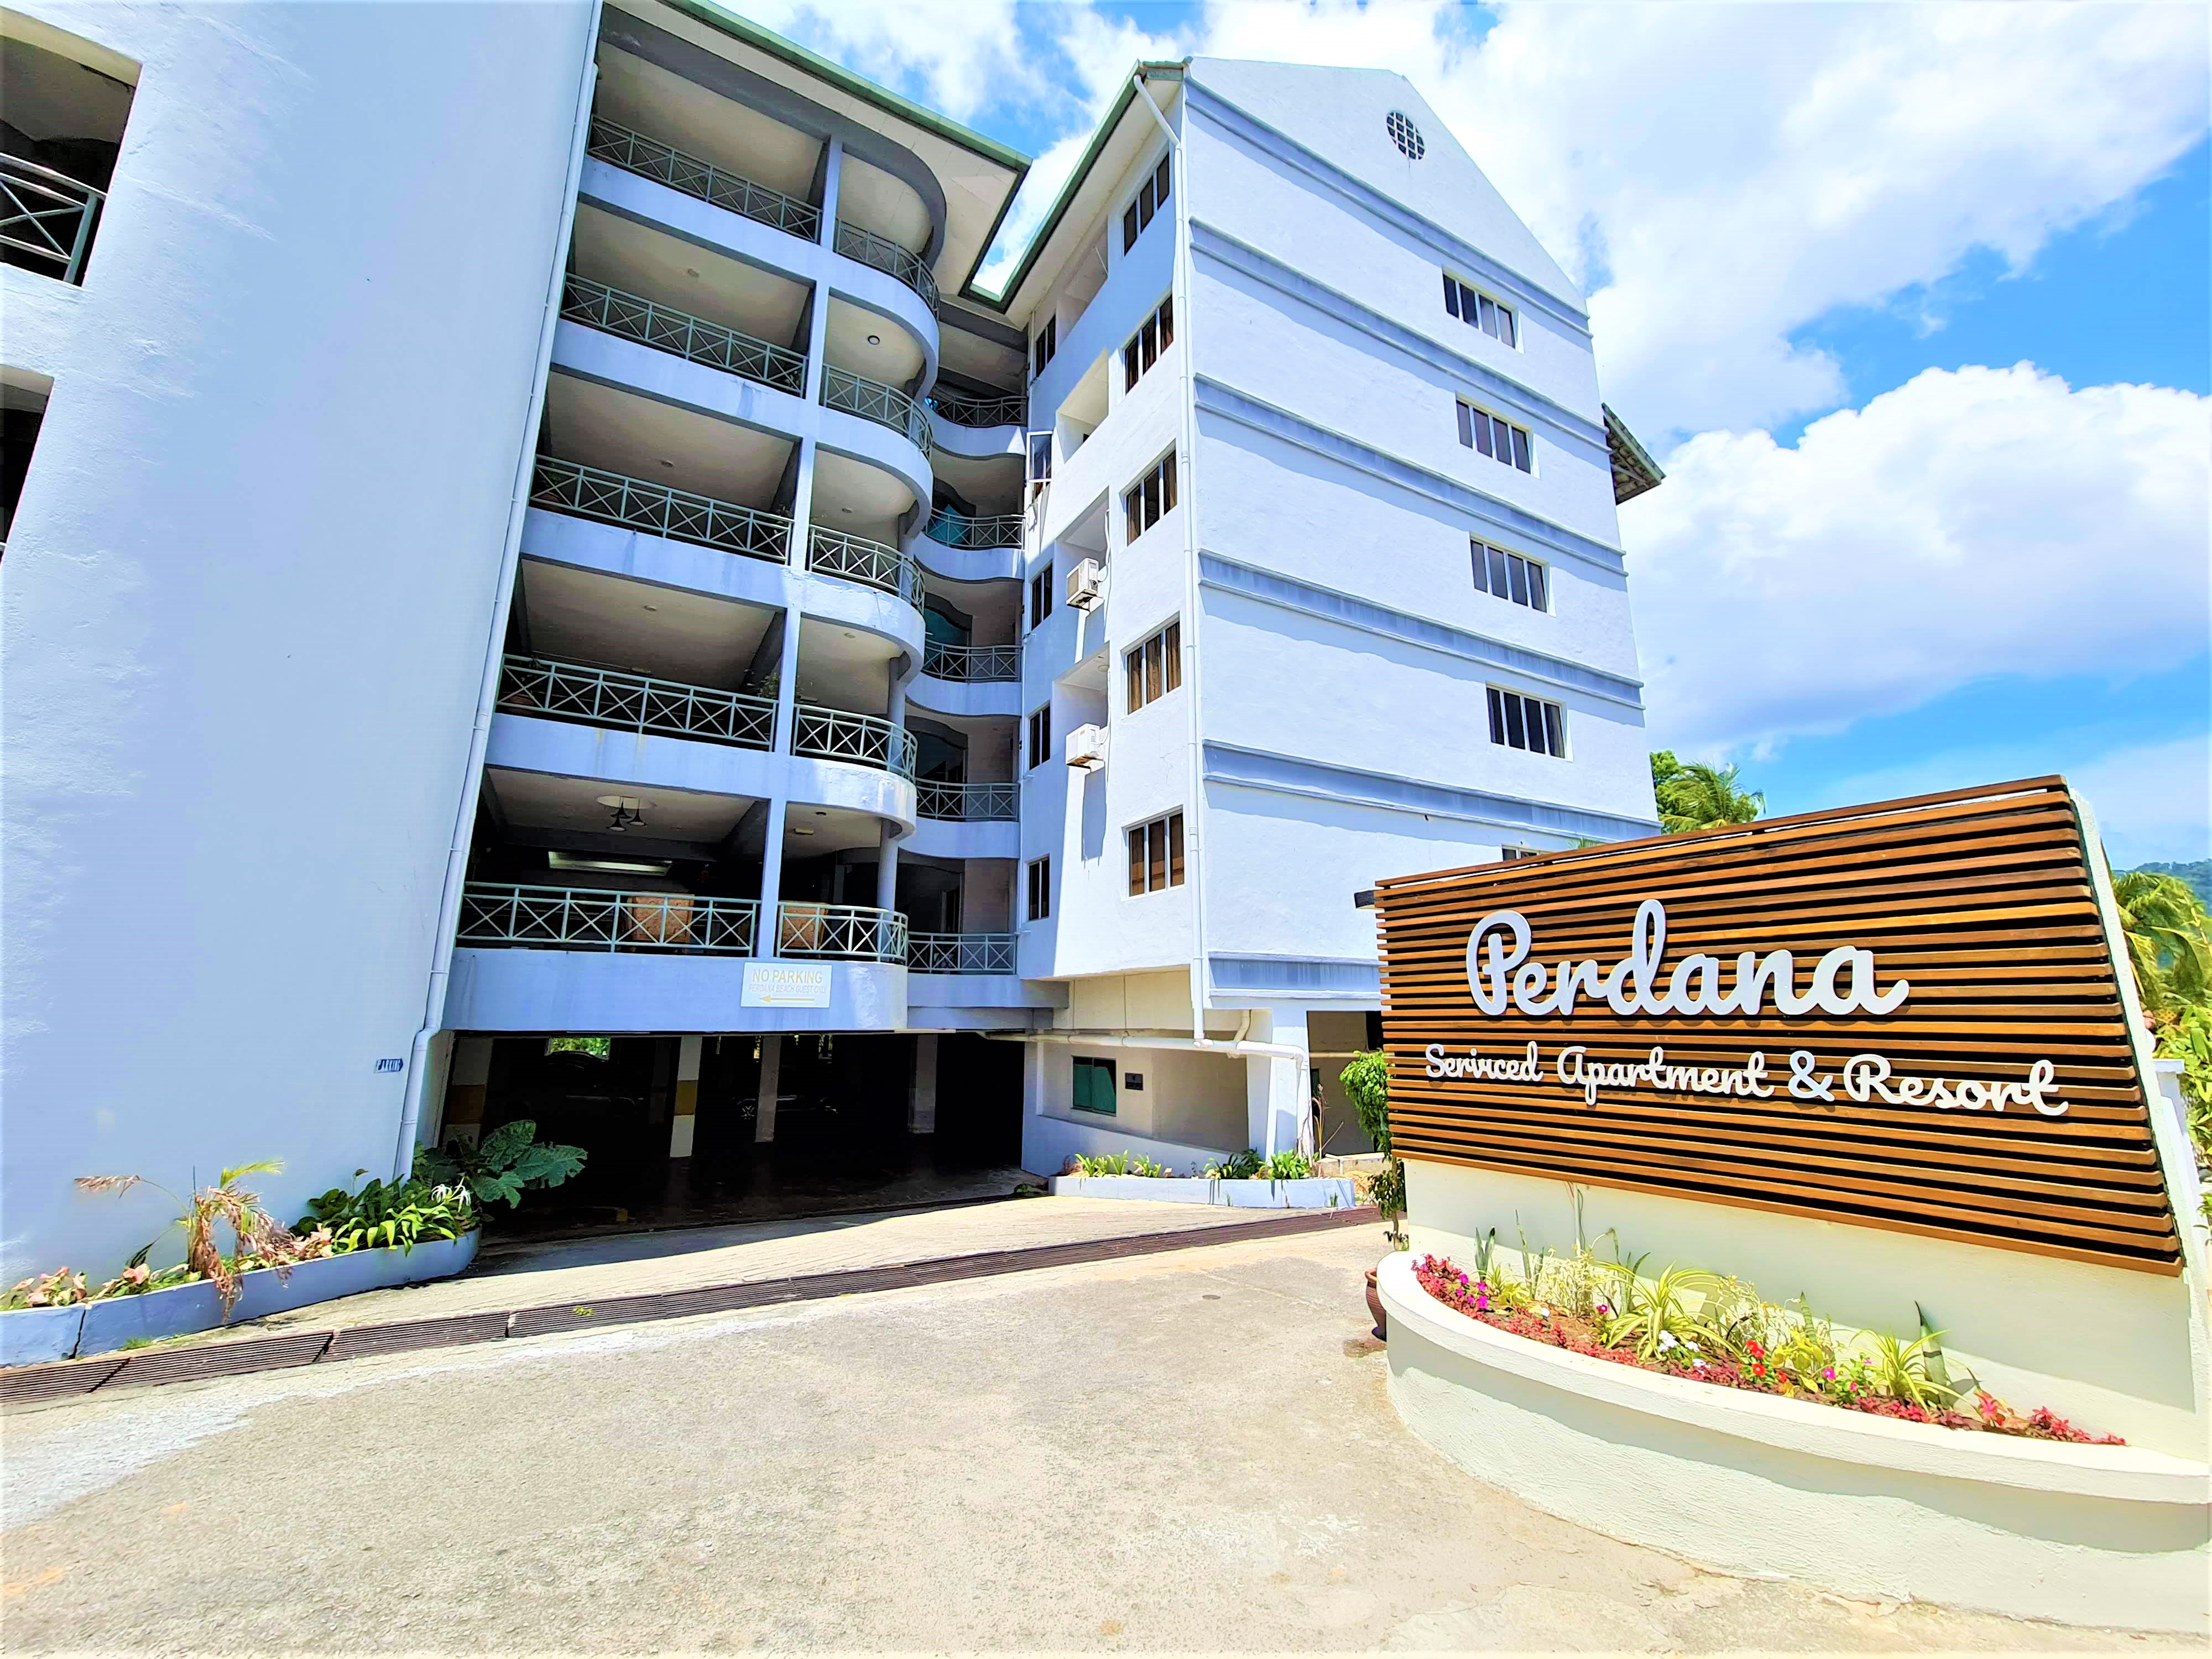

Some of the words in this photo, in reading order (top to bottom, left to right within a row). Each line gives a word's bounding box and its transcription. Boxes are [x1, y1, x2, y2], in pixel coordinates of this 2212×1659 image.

[753, 968, 770, 982] NO
[773, 969, 823, 984] PARKING
[1467, 899, 1910, 1016] Perdana
[776, 984, 795, 993] BEACH
[795, 985, 813, 994] GUEST
[814, 986, 828, 994] ONLY
[1557, 1046, 1774, 1106] Apartment
[1788, 1050, 1835, 1102] &
[1844, 1054, 2069, 1116] Resort
